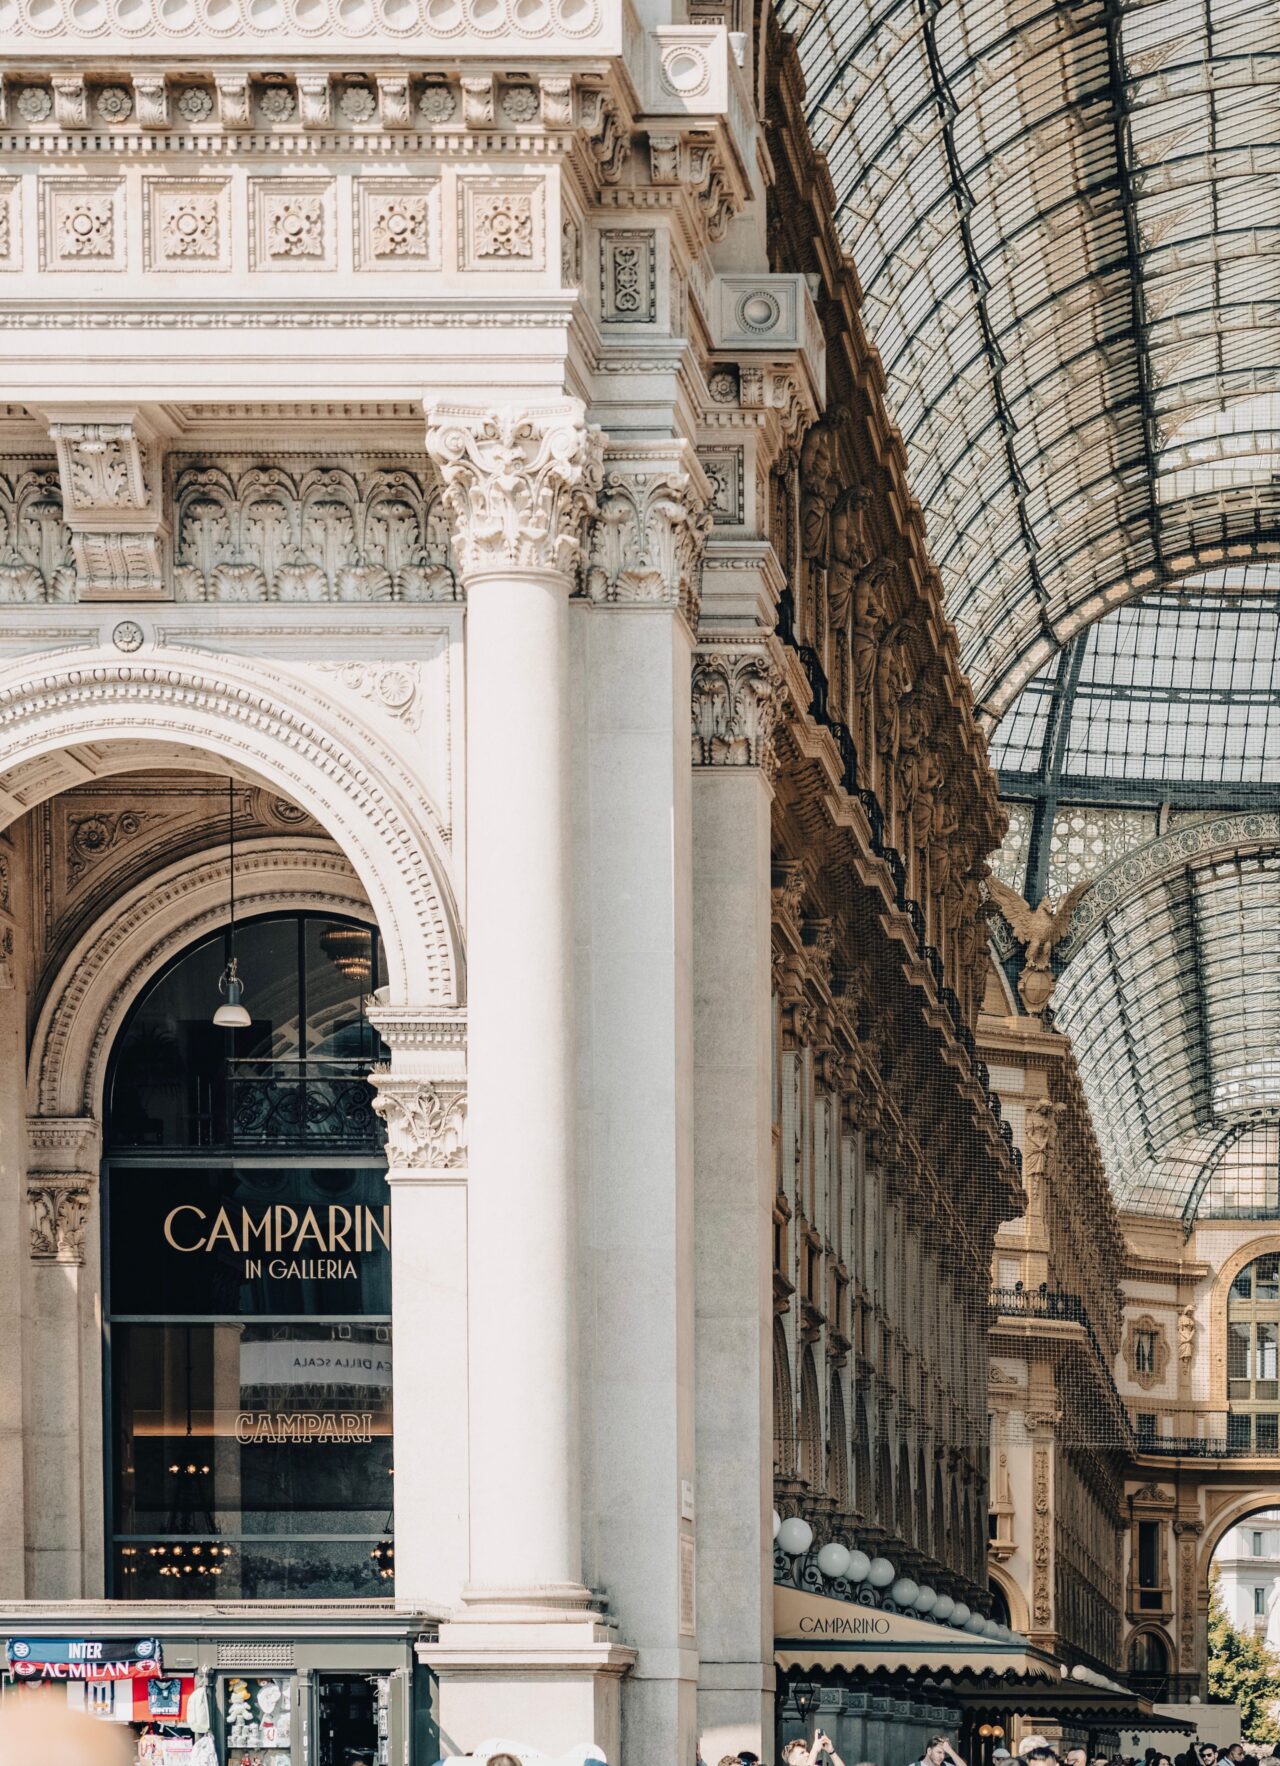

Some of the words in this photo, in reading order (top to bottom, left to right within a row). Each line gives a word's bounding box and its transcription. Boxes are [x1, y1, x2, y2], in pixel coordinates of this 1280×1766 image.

[245, 1259, 262, 1279] IN
[268, 1259, 358, 1279] GALLERIA
[234, 1413, 373, 1445] CAMPARI
[799, 1616, 890, 1635] CAMPARINO
[68, 1642, 102, 1659] INTER
[41, 1662, 67, 1678] AC
[69, 1660, 130, 1678] MILAN
